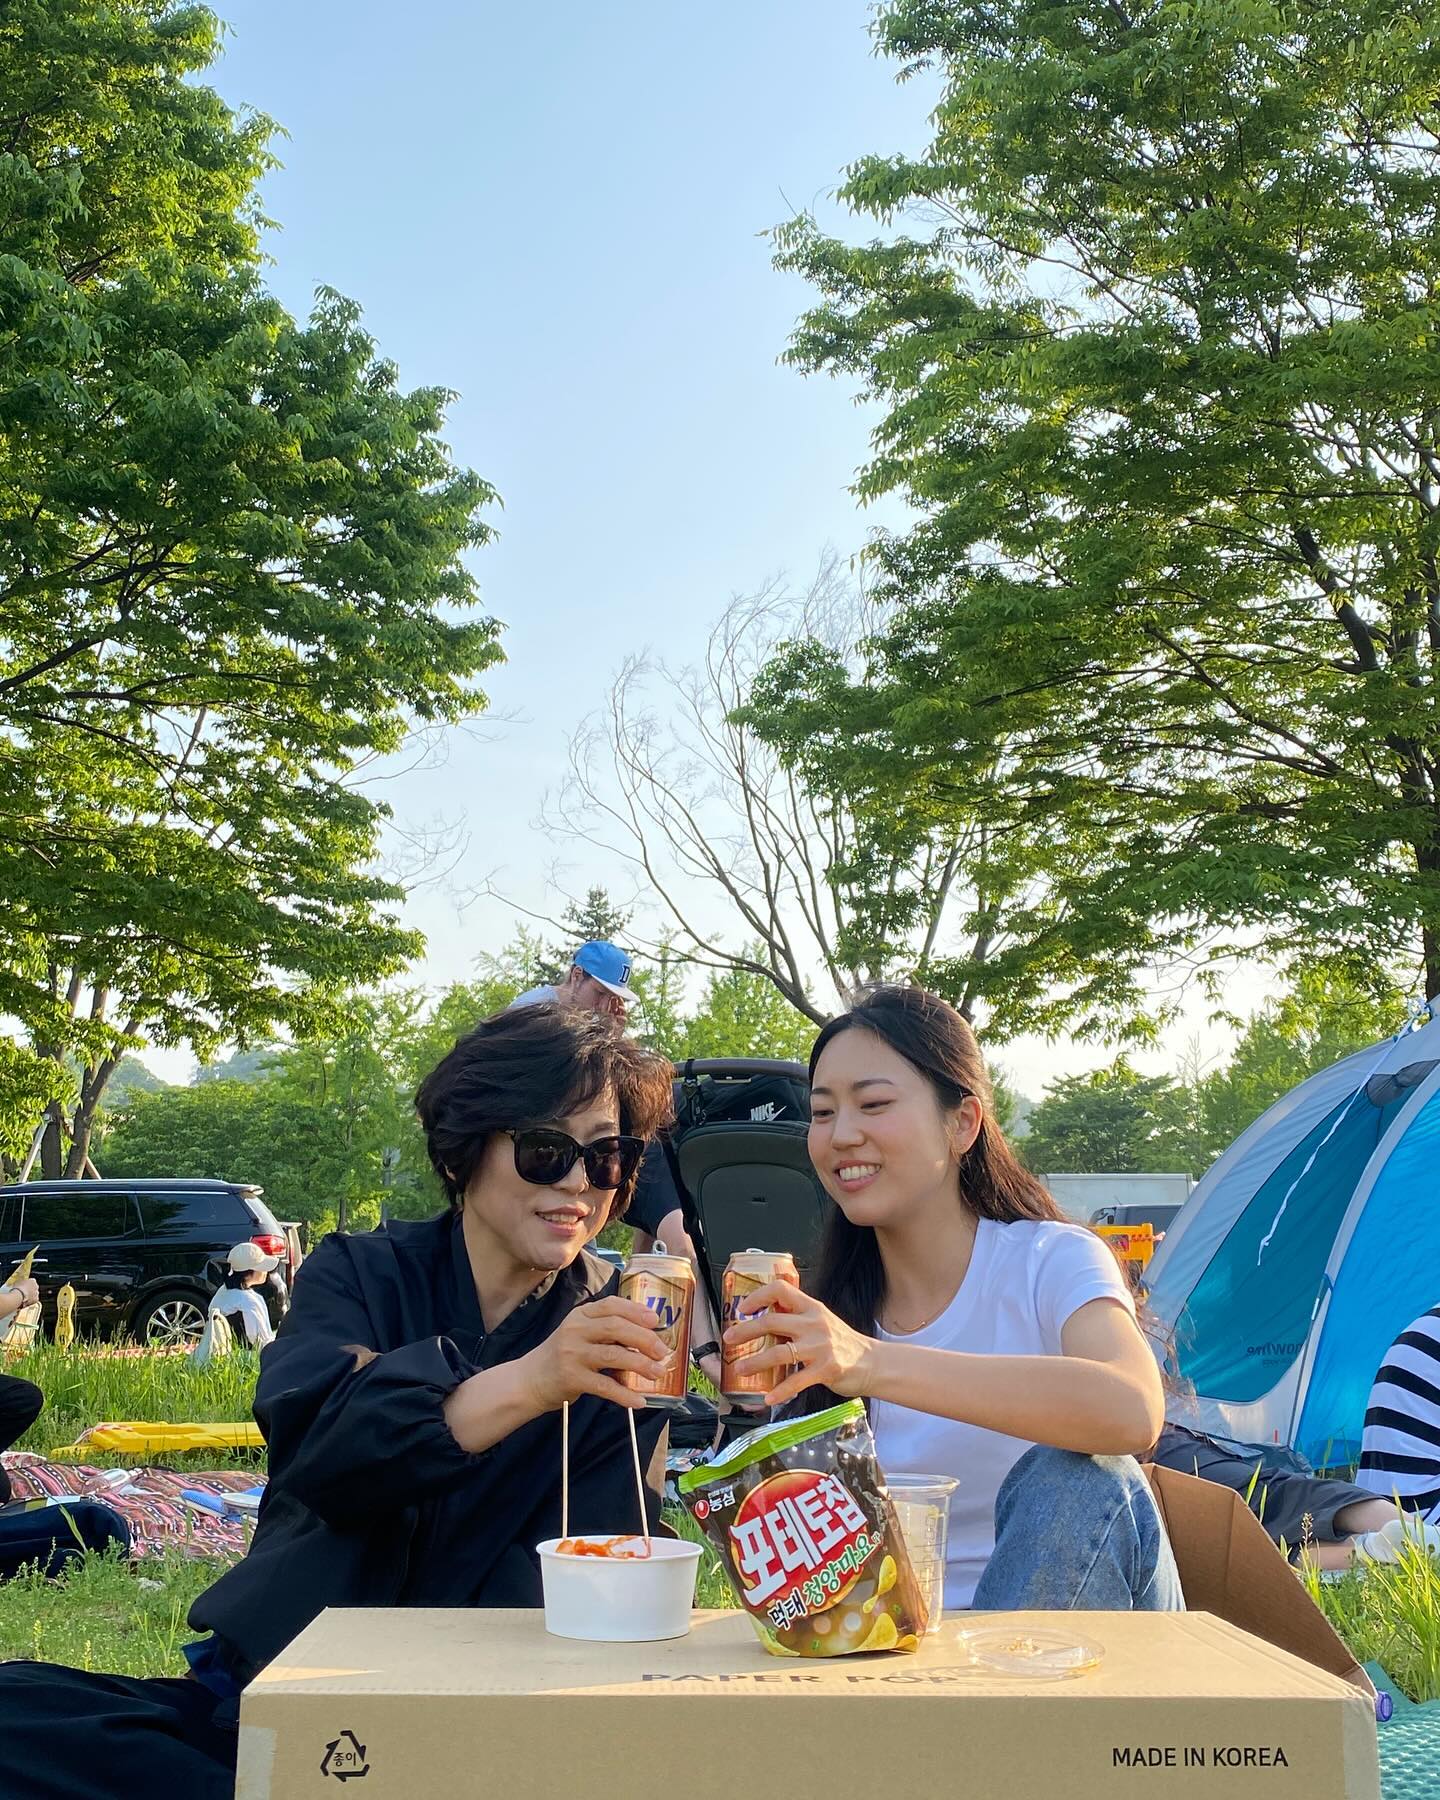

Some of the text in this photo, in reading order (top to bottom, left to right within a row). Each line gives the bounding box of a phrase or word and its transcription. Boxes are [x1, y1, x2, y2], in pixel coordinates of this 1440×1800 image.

[750, 1101, 775, 1121] NIKE
[708, 1490, 736, 1512] 농심
[730, 1474, 869, 1607] 포테토칩
[770, 1588, 807, 1629] 먹태
[642, 1674, 957, 1683] PAPER POP
[333, 1752, 356, 1767] 종이
[1112, 1747, 1289, 1767] MADE IN KOREA
